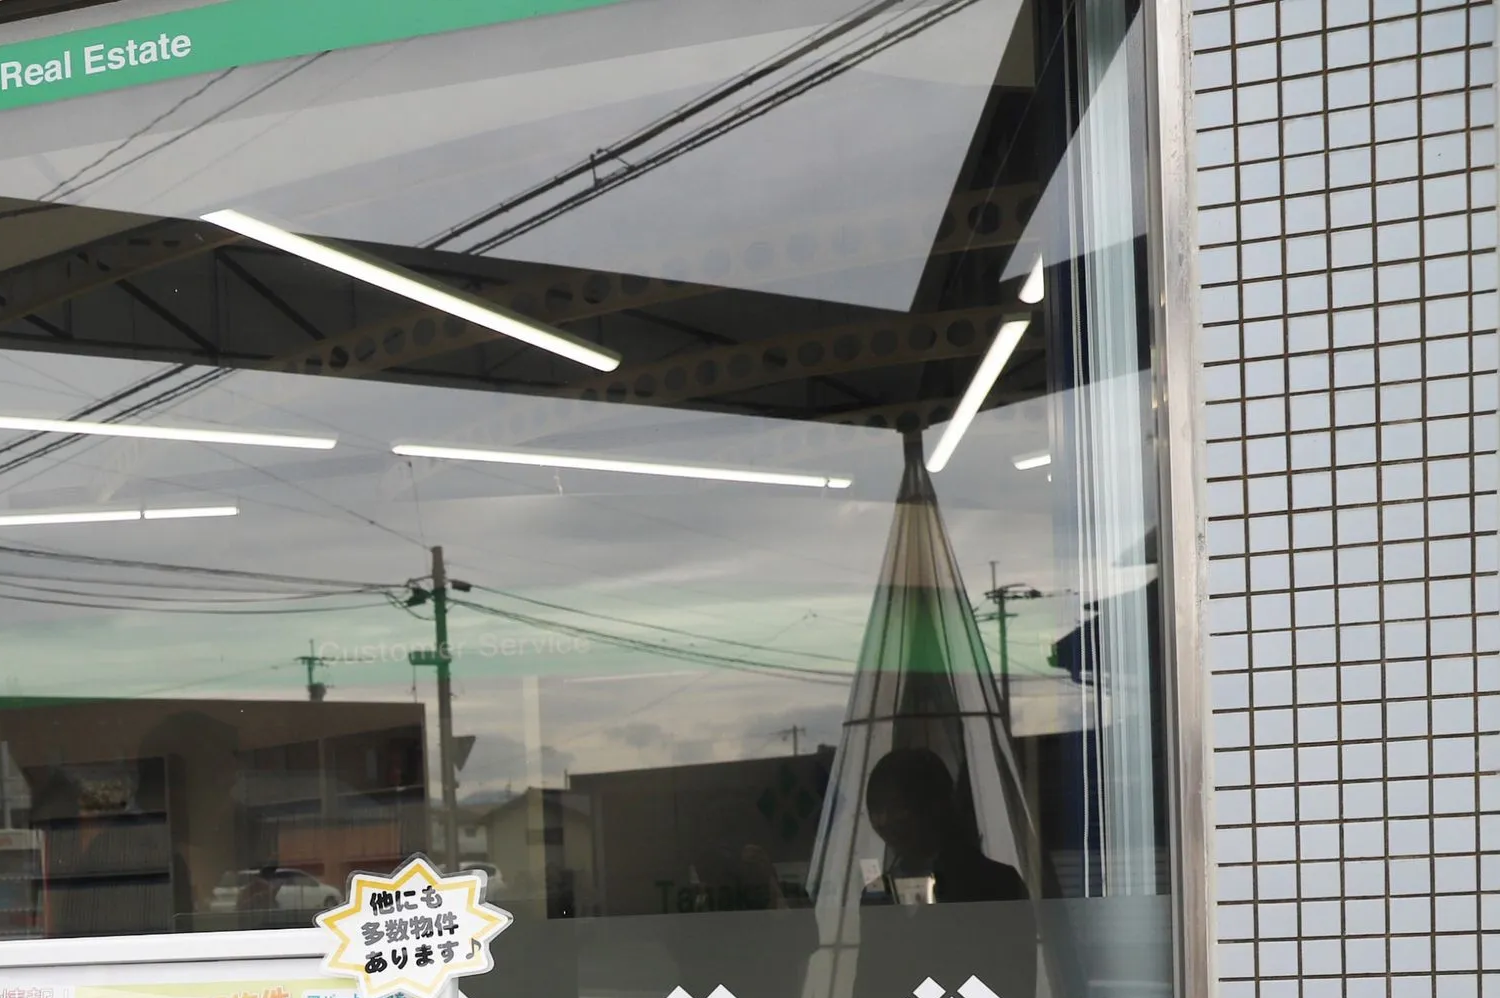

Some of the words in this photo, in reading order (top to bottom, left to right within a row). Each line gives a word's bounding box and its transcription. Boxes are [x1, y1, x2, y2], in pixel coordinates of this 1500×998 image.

[0, 50, 72, 90] Real
[83, 33, 191, 75] Estate
[318, 639, 465, 665] Customer
[480, 632, 591, 657] Service
[369, 885, 443, 916] 他にも
[361, 911, 459, 946] 多数物件
